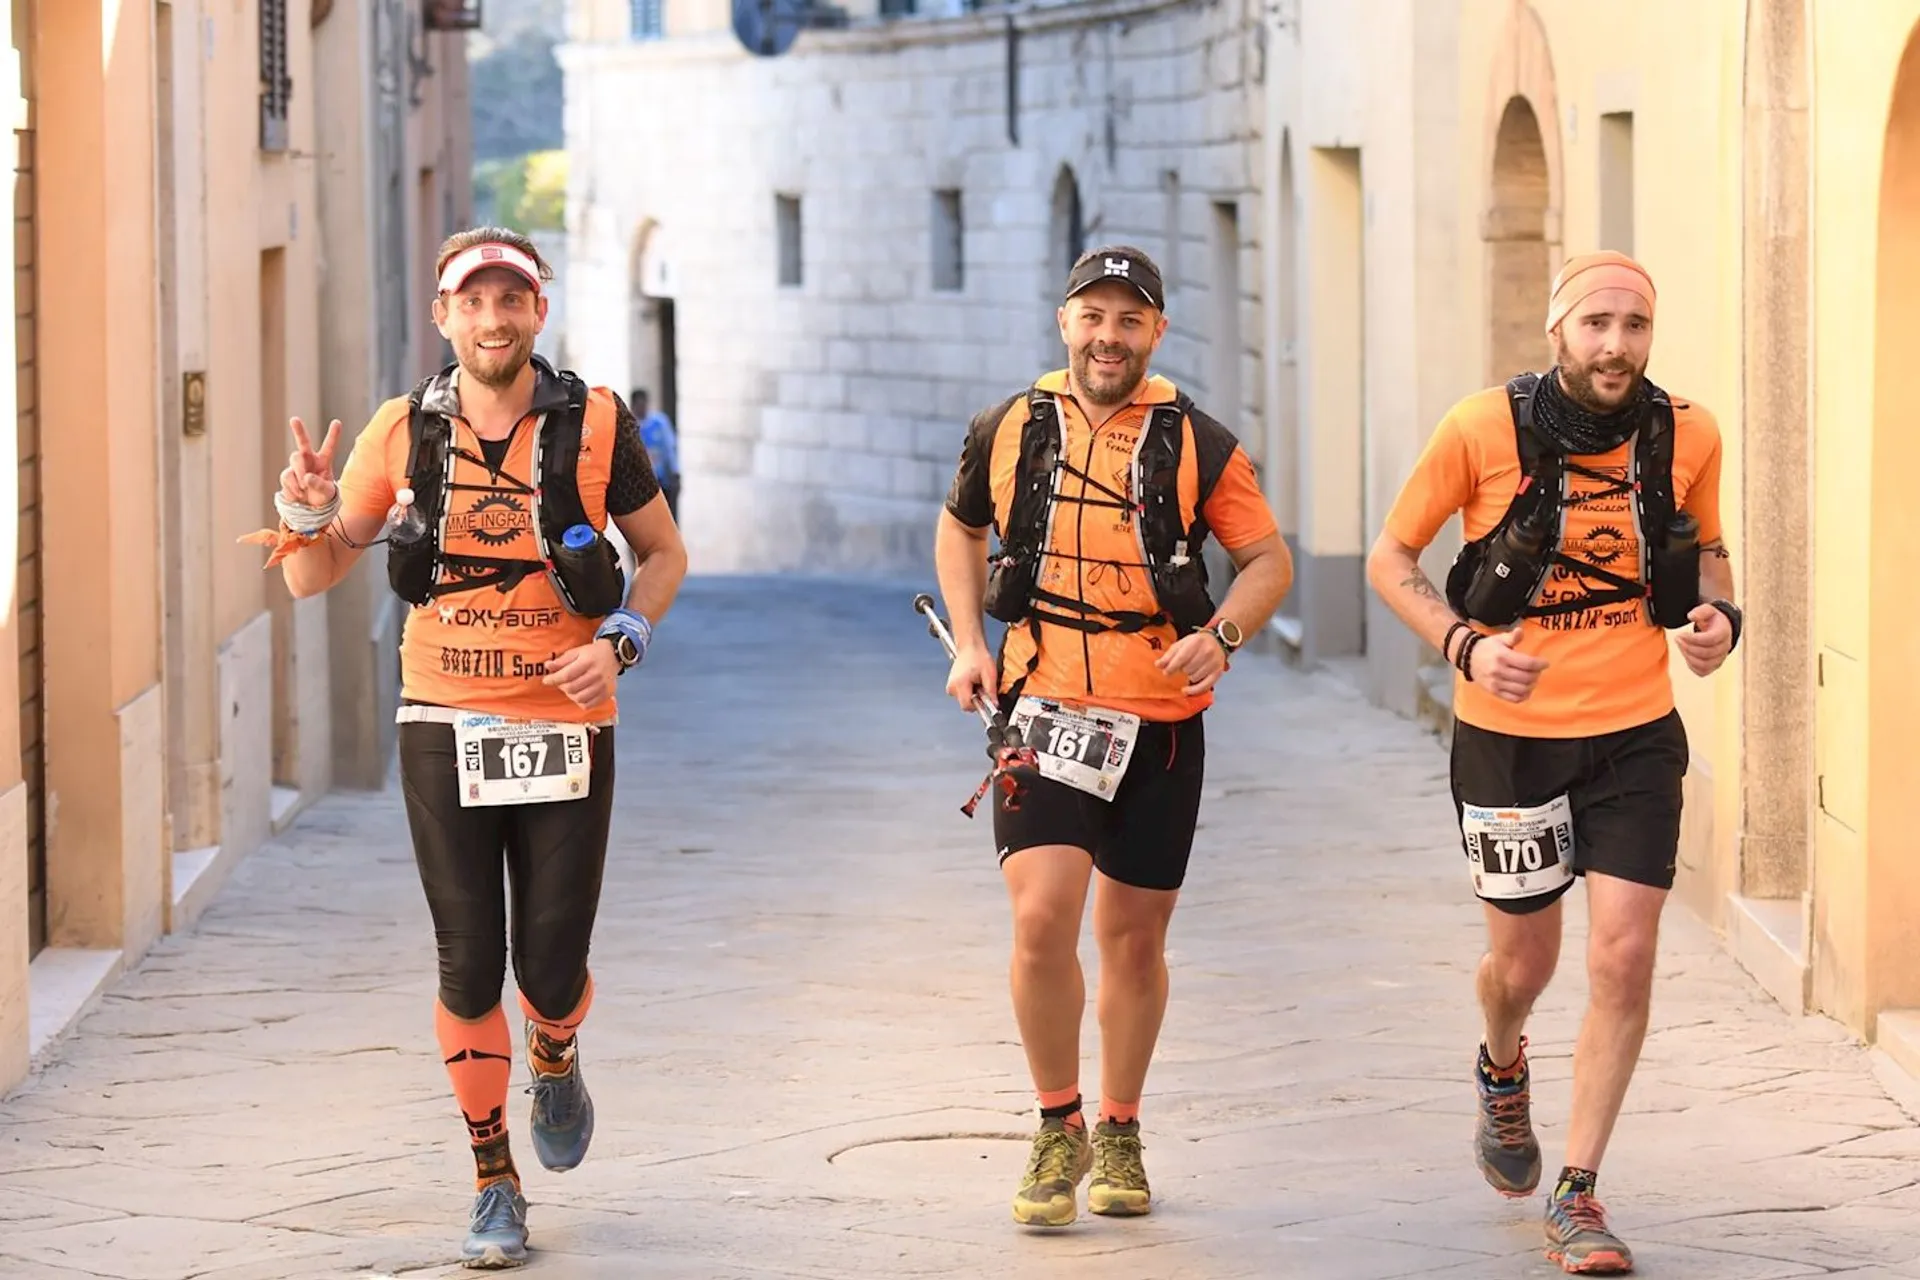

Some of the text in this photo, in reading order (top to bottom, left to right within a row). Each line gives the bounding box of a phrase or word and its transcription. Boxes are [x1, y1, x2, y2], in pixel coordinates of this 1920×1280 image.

[512, 652, 557, 680] Spo
[498, 742, 549, 778] 167
[1048, 726, 1091, 762] 161
[1493, 839, 1543, 873] 170
